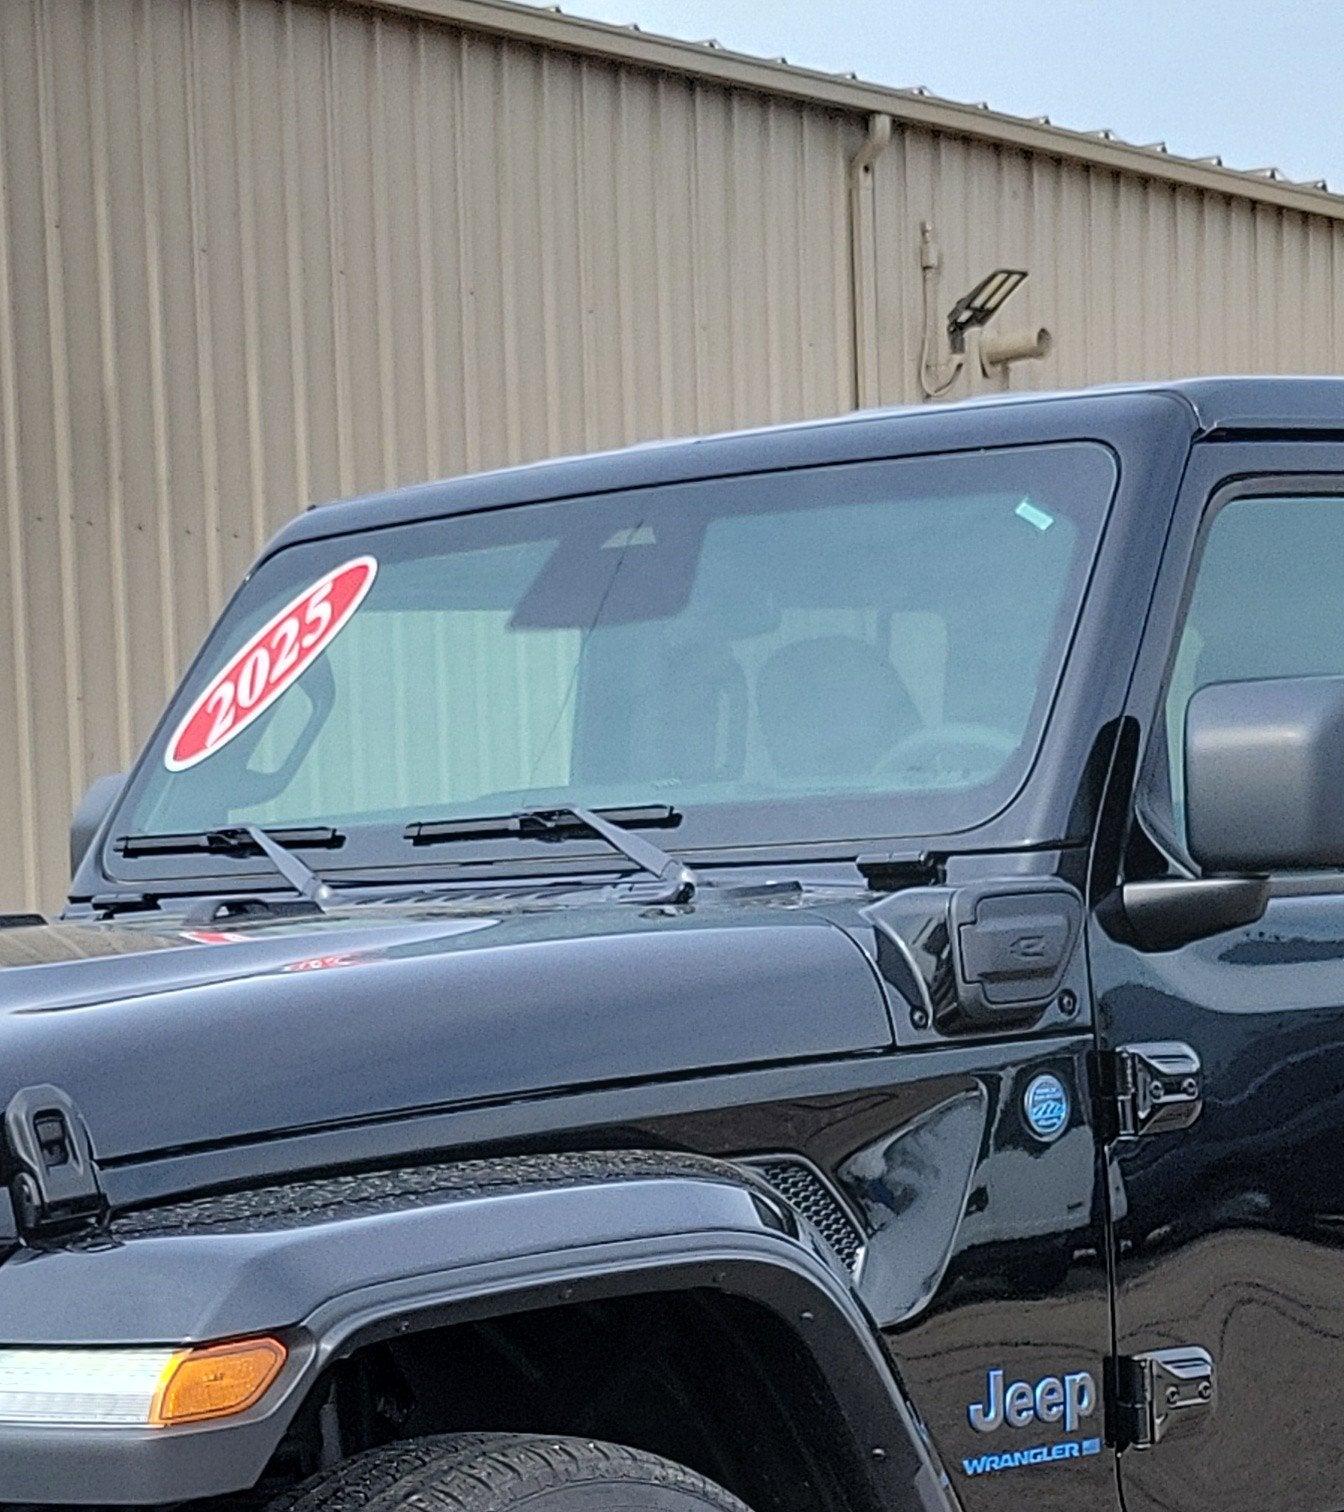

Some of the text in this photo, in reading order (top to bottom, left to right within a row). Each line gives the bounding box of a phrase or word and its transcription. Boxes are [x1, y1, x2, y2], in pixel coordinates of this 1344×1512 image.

[205, 580, 333, 749] 2025
[967, 1369, 1096, 1434] Jeep
[961, 1442, 1081, 1476] WRANGLER
